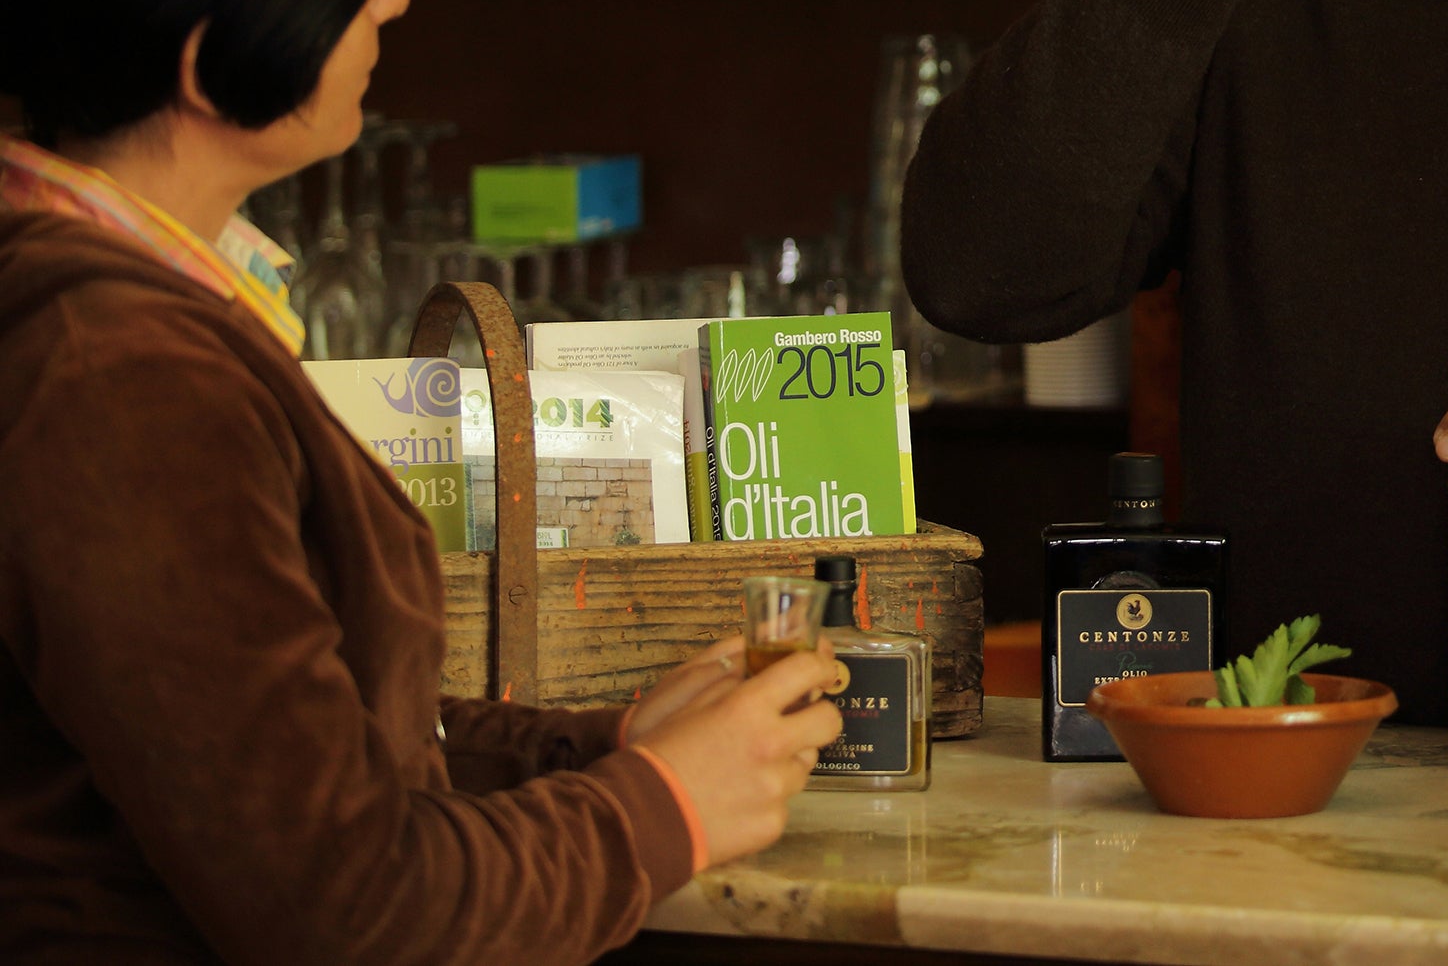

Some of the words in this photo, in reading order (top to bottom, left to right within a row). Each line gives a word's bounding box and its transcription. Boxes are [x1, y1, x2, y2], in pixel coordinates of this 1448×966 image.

[774, 330, 836, 347] Gambero
[840, 329, 882, 343] Rosso
[777, 343, 885, 400] 2015
[532, 397, 614, 428] 014
[706, 425, 715, 448] Oli
[719, 421, 781, 481] Oli
[724, 480, 873, 542] d'Italia
[1079, 631, 1190, 644] CENTONZE
[1122, 670, 1148, 678] OLIO
